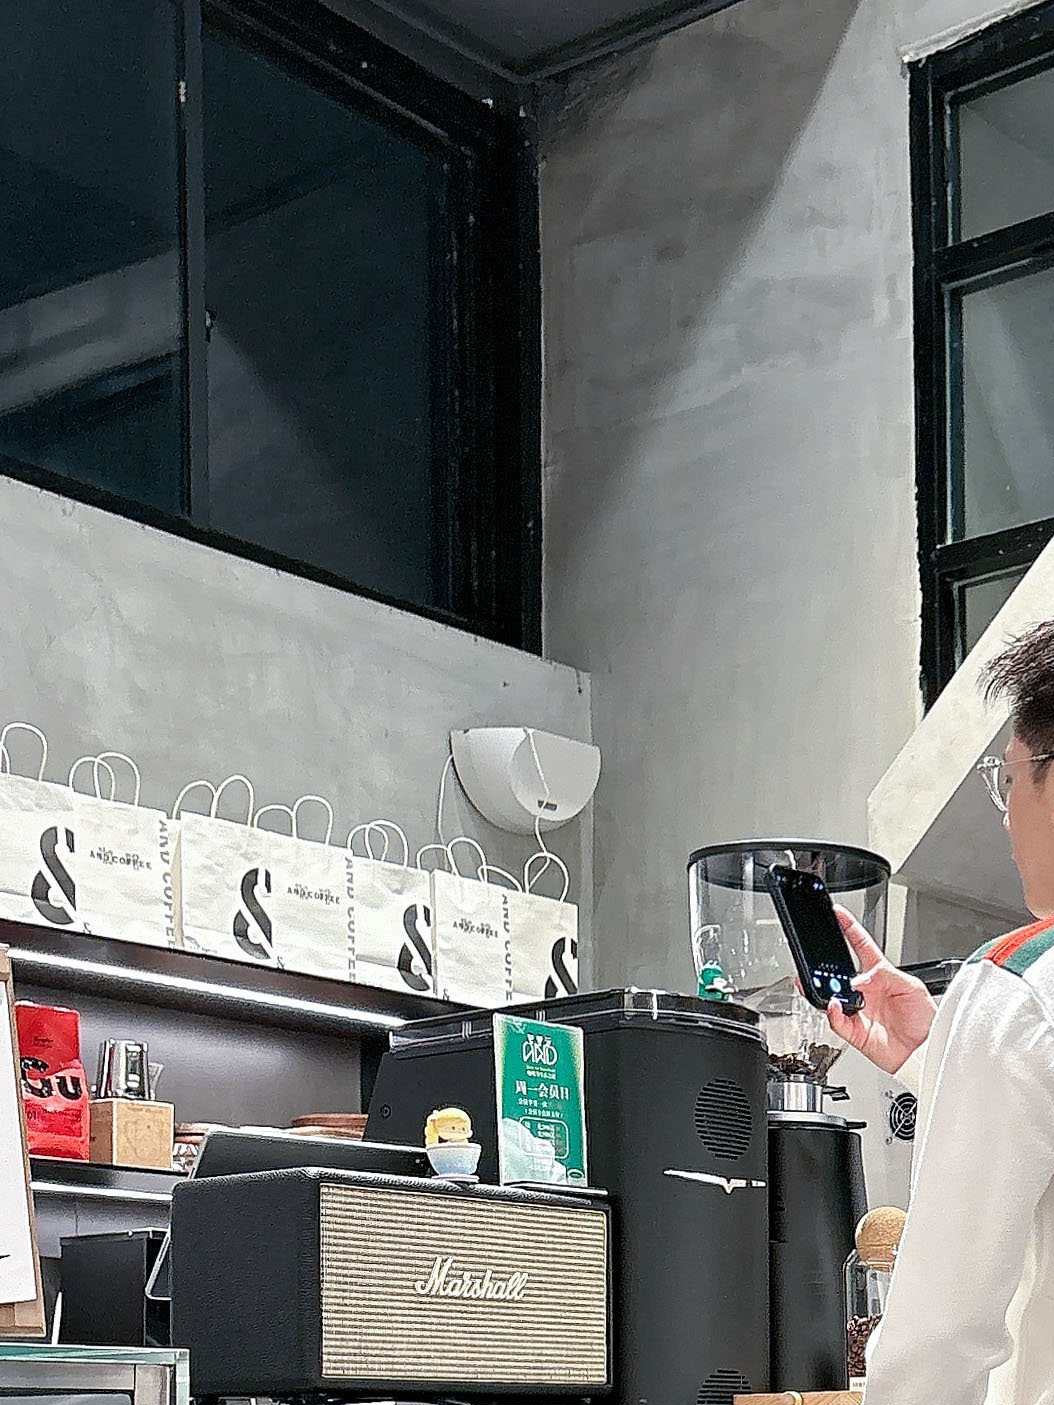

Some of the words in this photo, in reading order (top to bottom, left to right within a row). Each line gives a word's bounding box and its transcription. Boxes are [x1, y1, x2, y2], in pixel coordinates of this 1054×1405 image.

[515, 1080, 569, 1100] 周一会员日
[414, 1256, 529, 1300] Marshall
